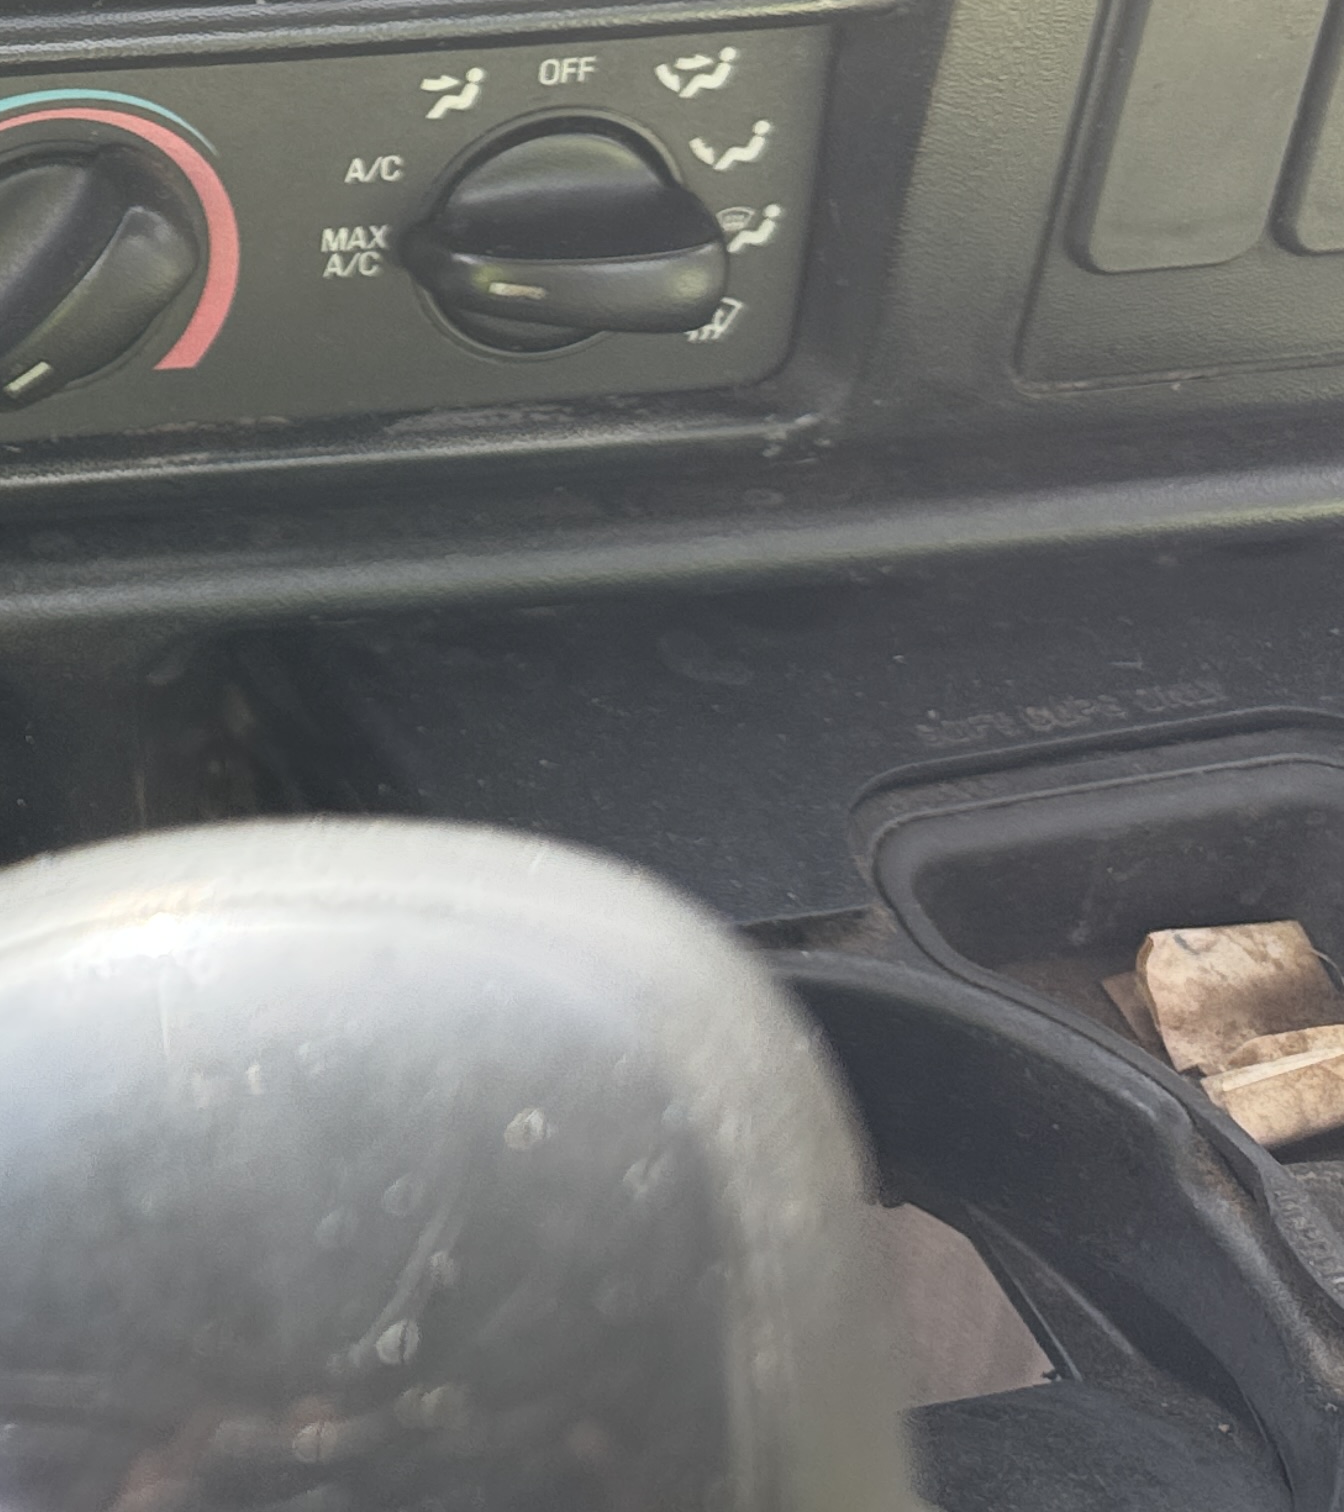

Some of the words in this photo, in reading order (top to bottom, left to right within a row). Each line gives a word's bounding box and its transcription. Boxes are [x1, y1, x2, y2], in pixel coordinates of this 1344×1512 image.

[538, 57, 598, 86] OFF
[345, 156, 404, 183] A/C
[321, 225, 390, 252] MAX
[323, 252, 381, 278] A/C
